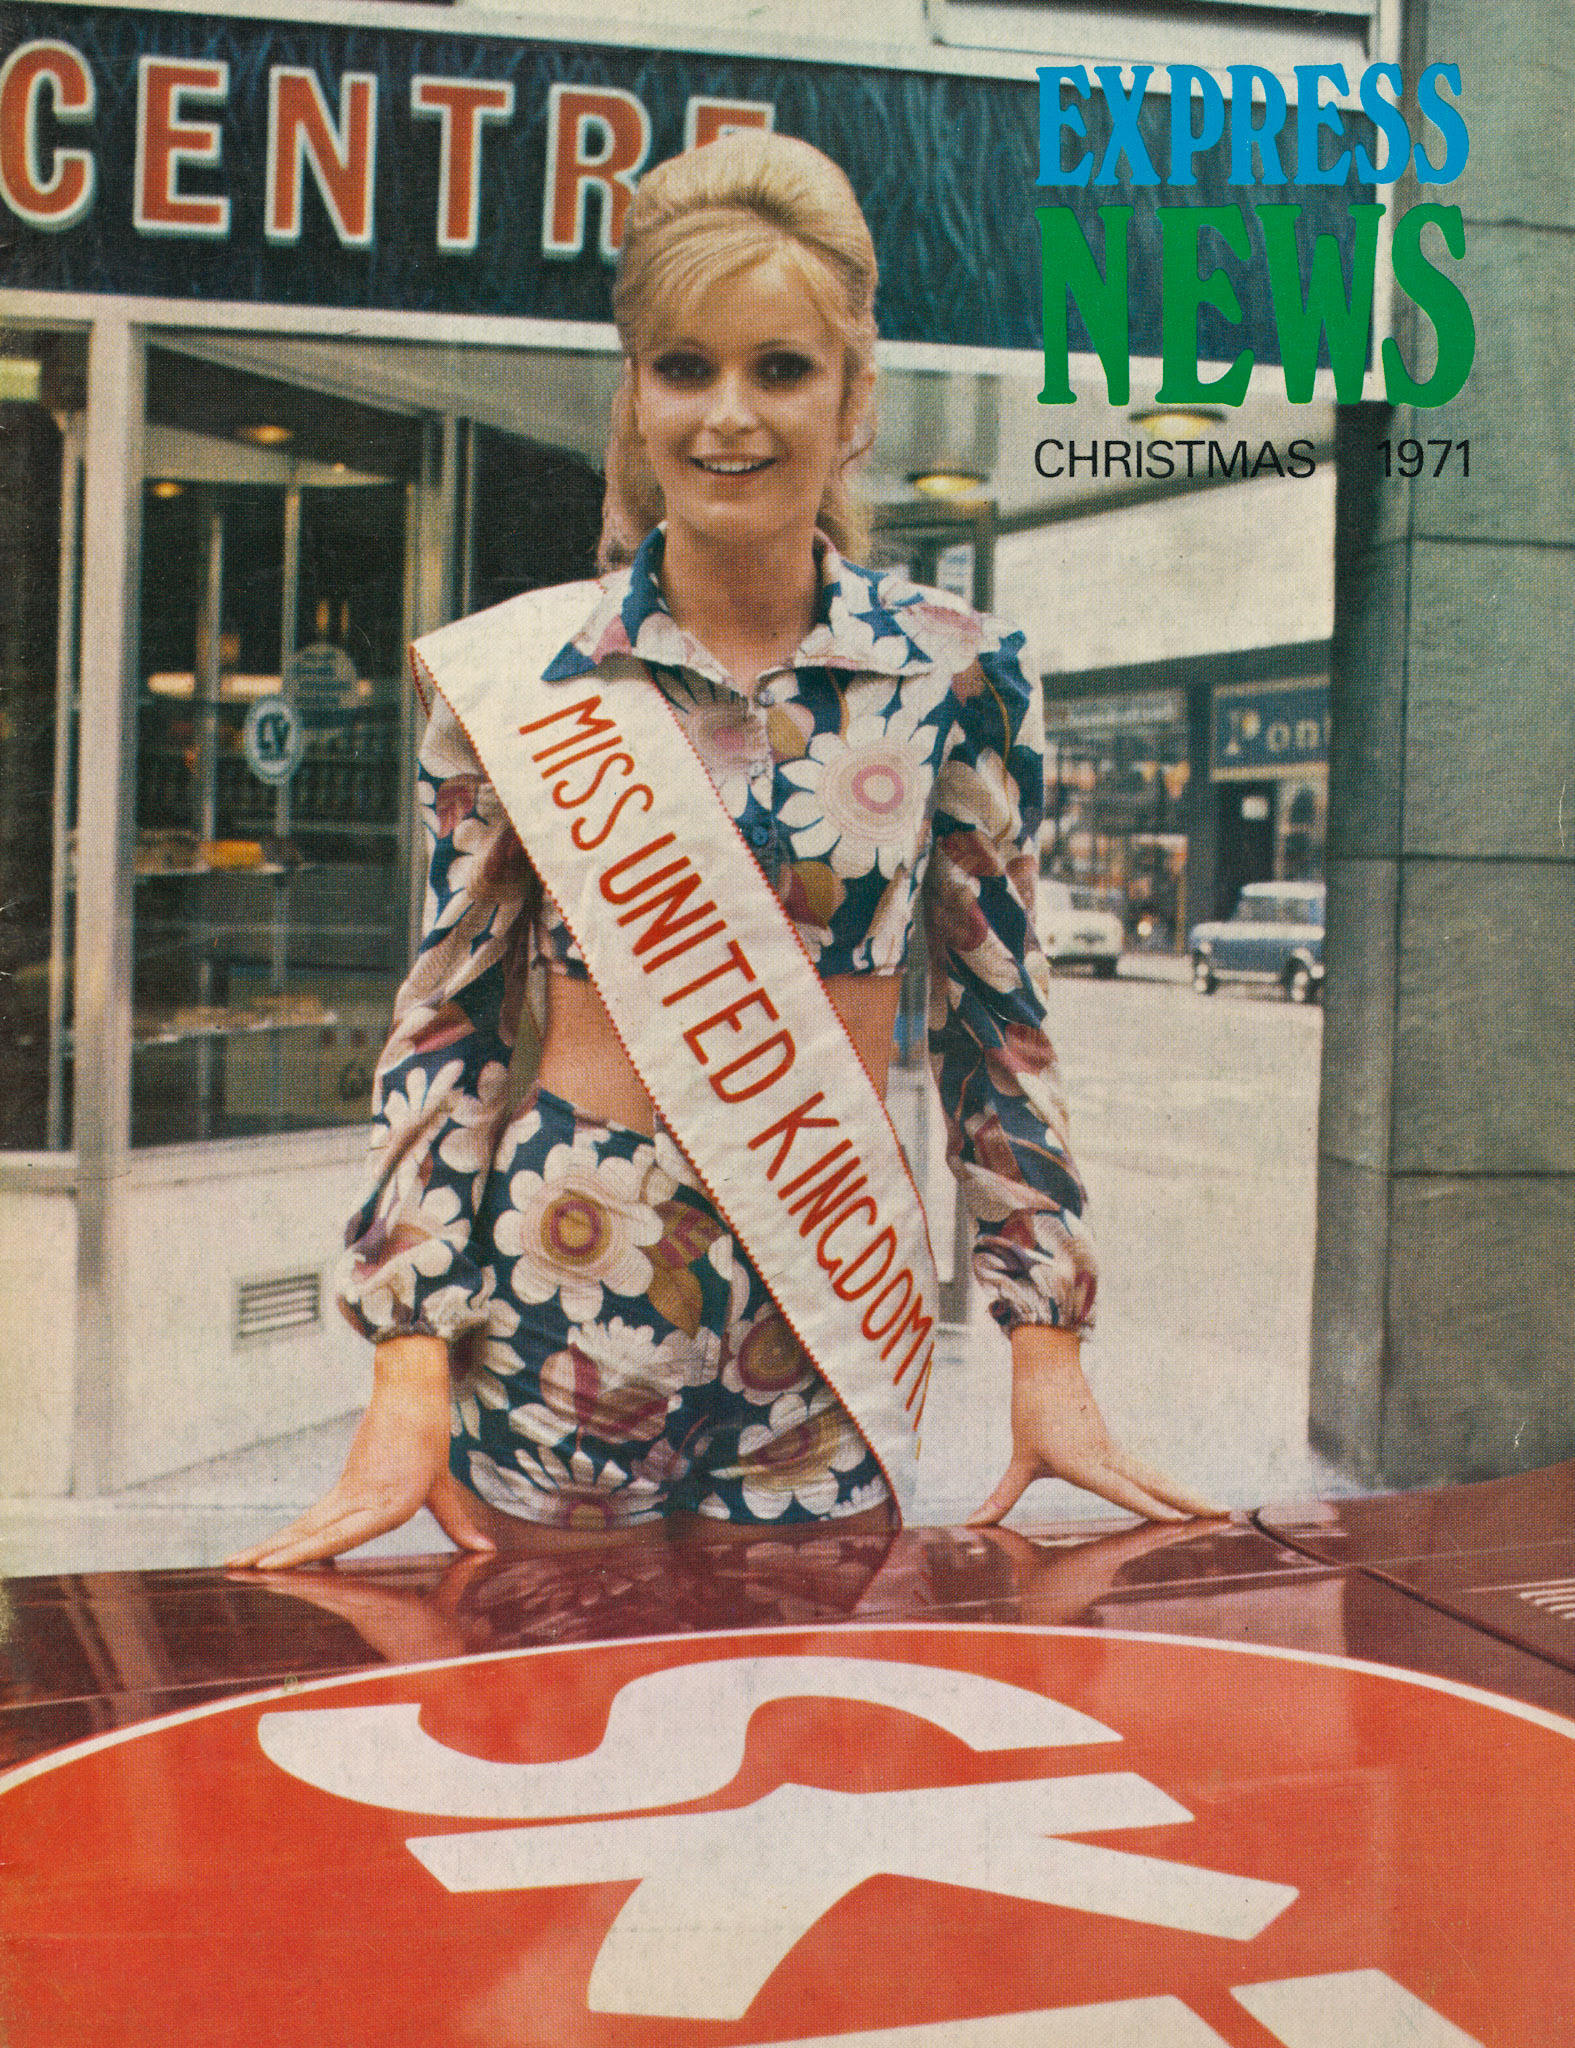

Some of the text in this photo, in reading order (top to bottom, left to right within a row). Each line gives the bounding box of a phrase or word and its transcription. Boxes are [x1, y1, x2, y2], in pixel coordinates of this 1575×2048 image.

[519, 694, 934, 1387] MISS UNITED KINGDOM
